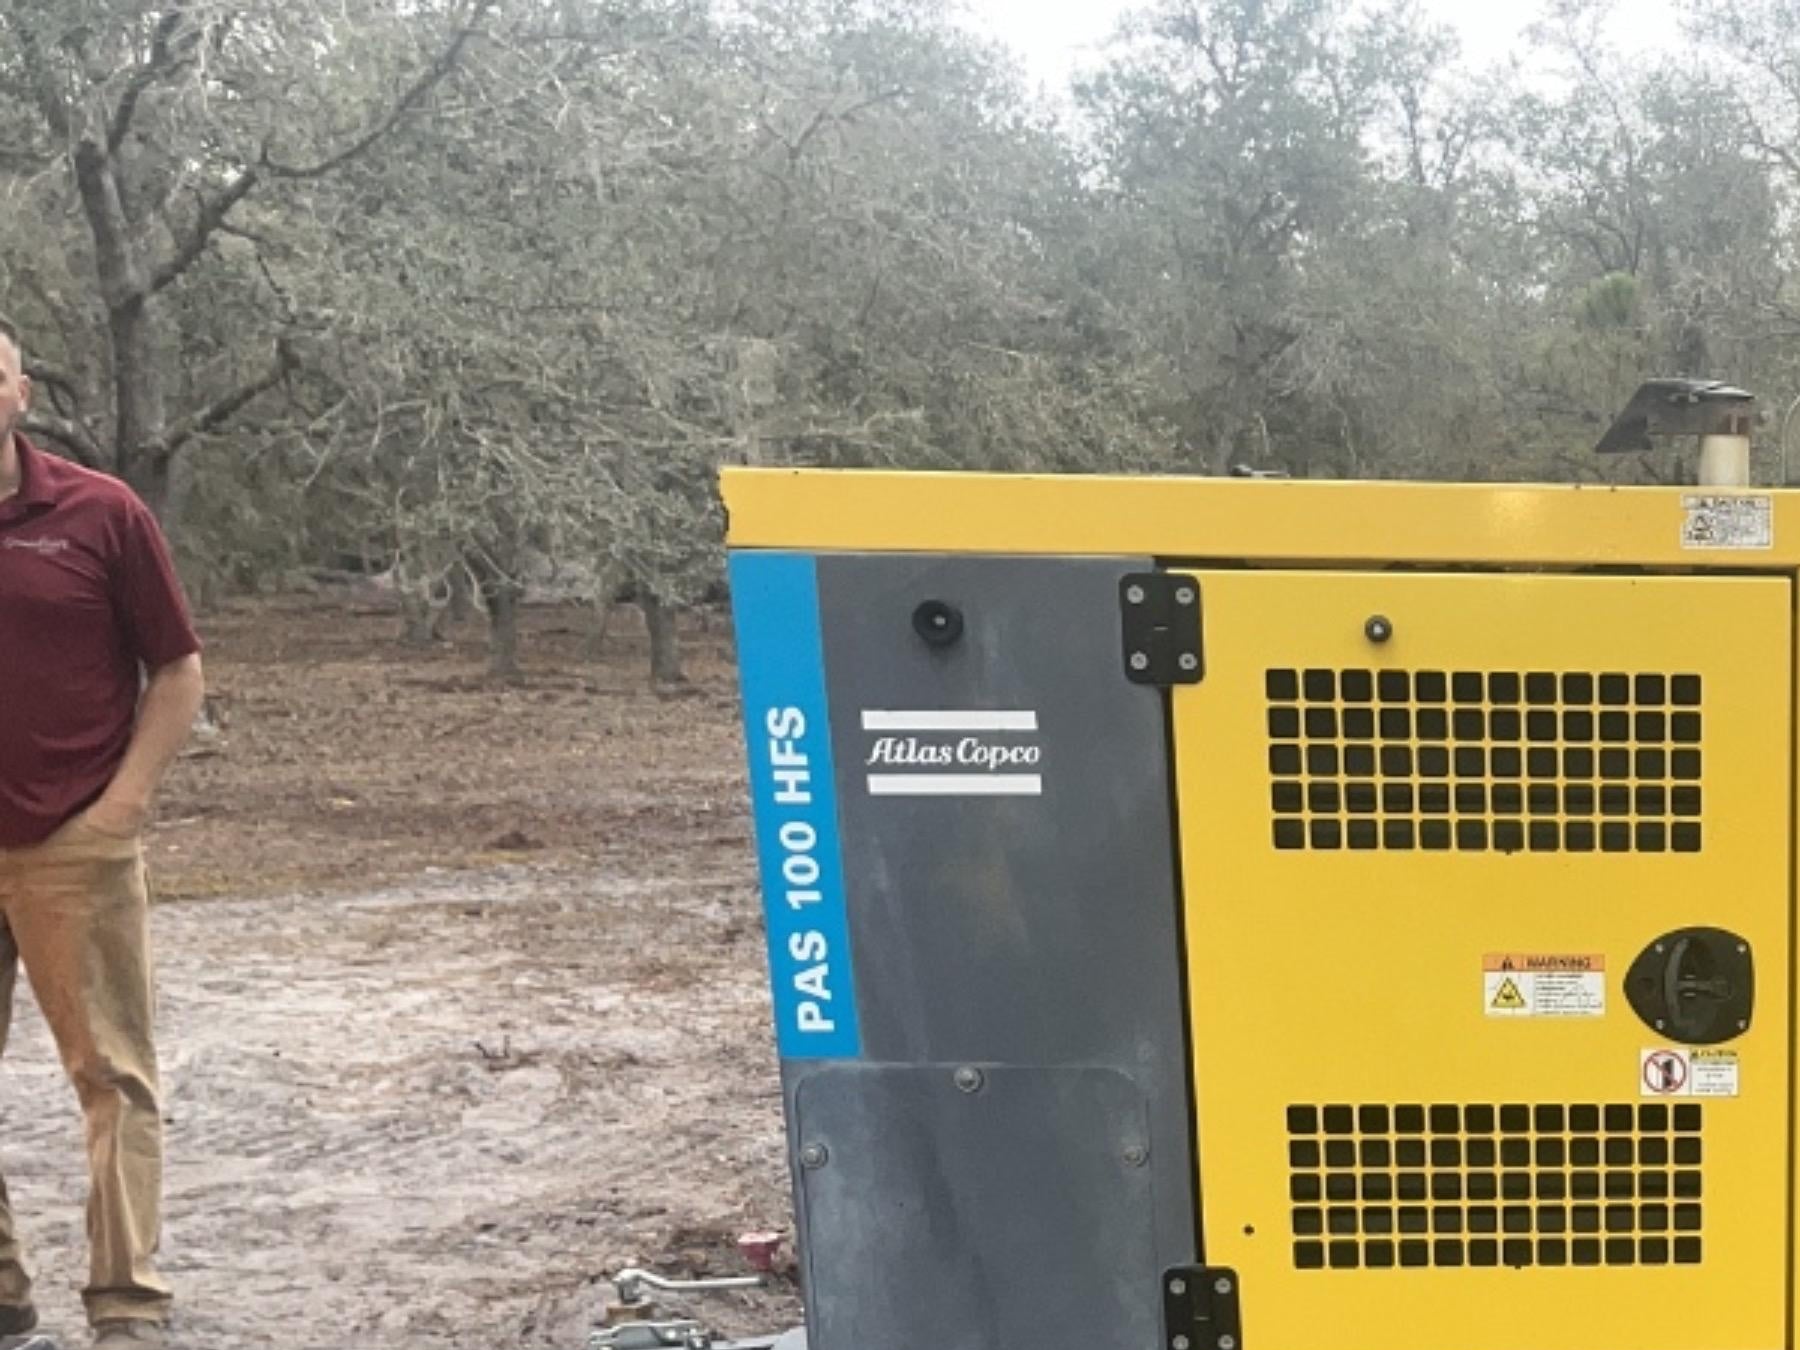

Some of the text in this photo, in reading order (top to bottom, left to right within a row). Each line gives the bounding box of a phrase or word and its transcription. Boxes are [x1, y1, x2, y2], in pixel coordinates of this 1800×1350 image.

[867, 737, 1041, 770] Atlas Copco
[767, 706, 835, 1032] PAS 100 HFS
[1526, 957, 1592, 969] WARNING
